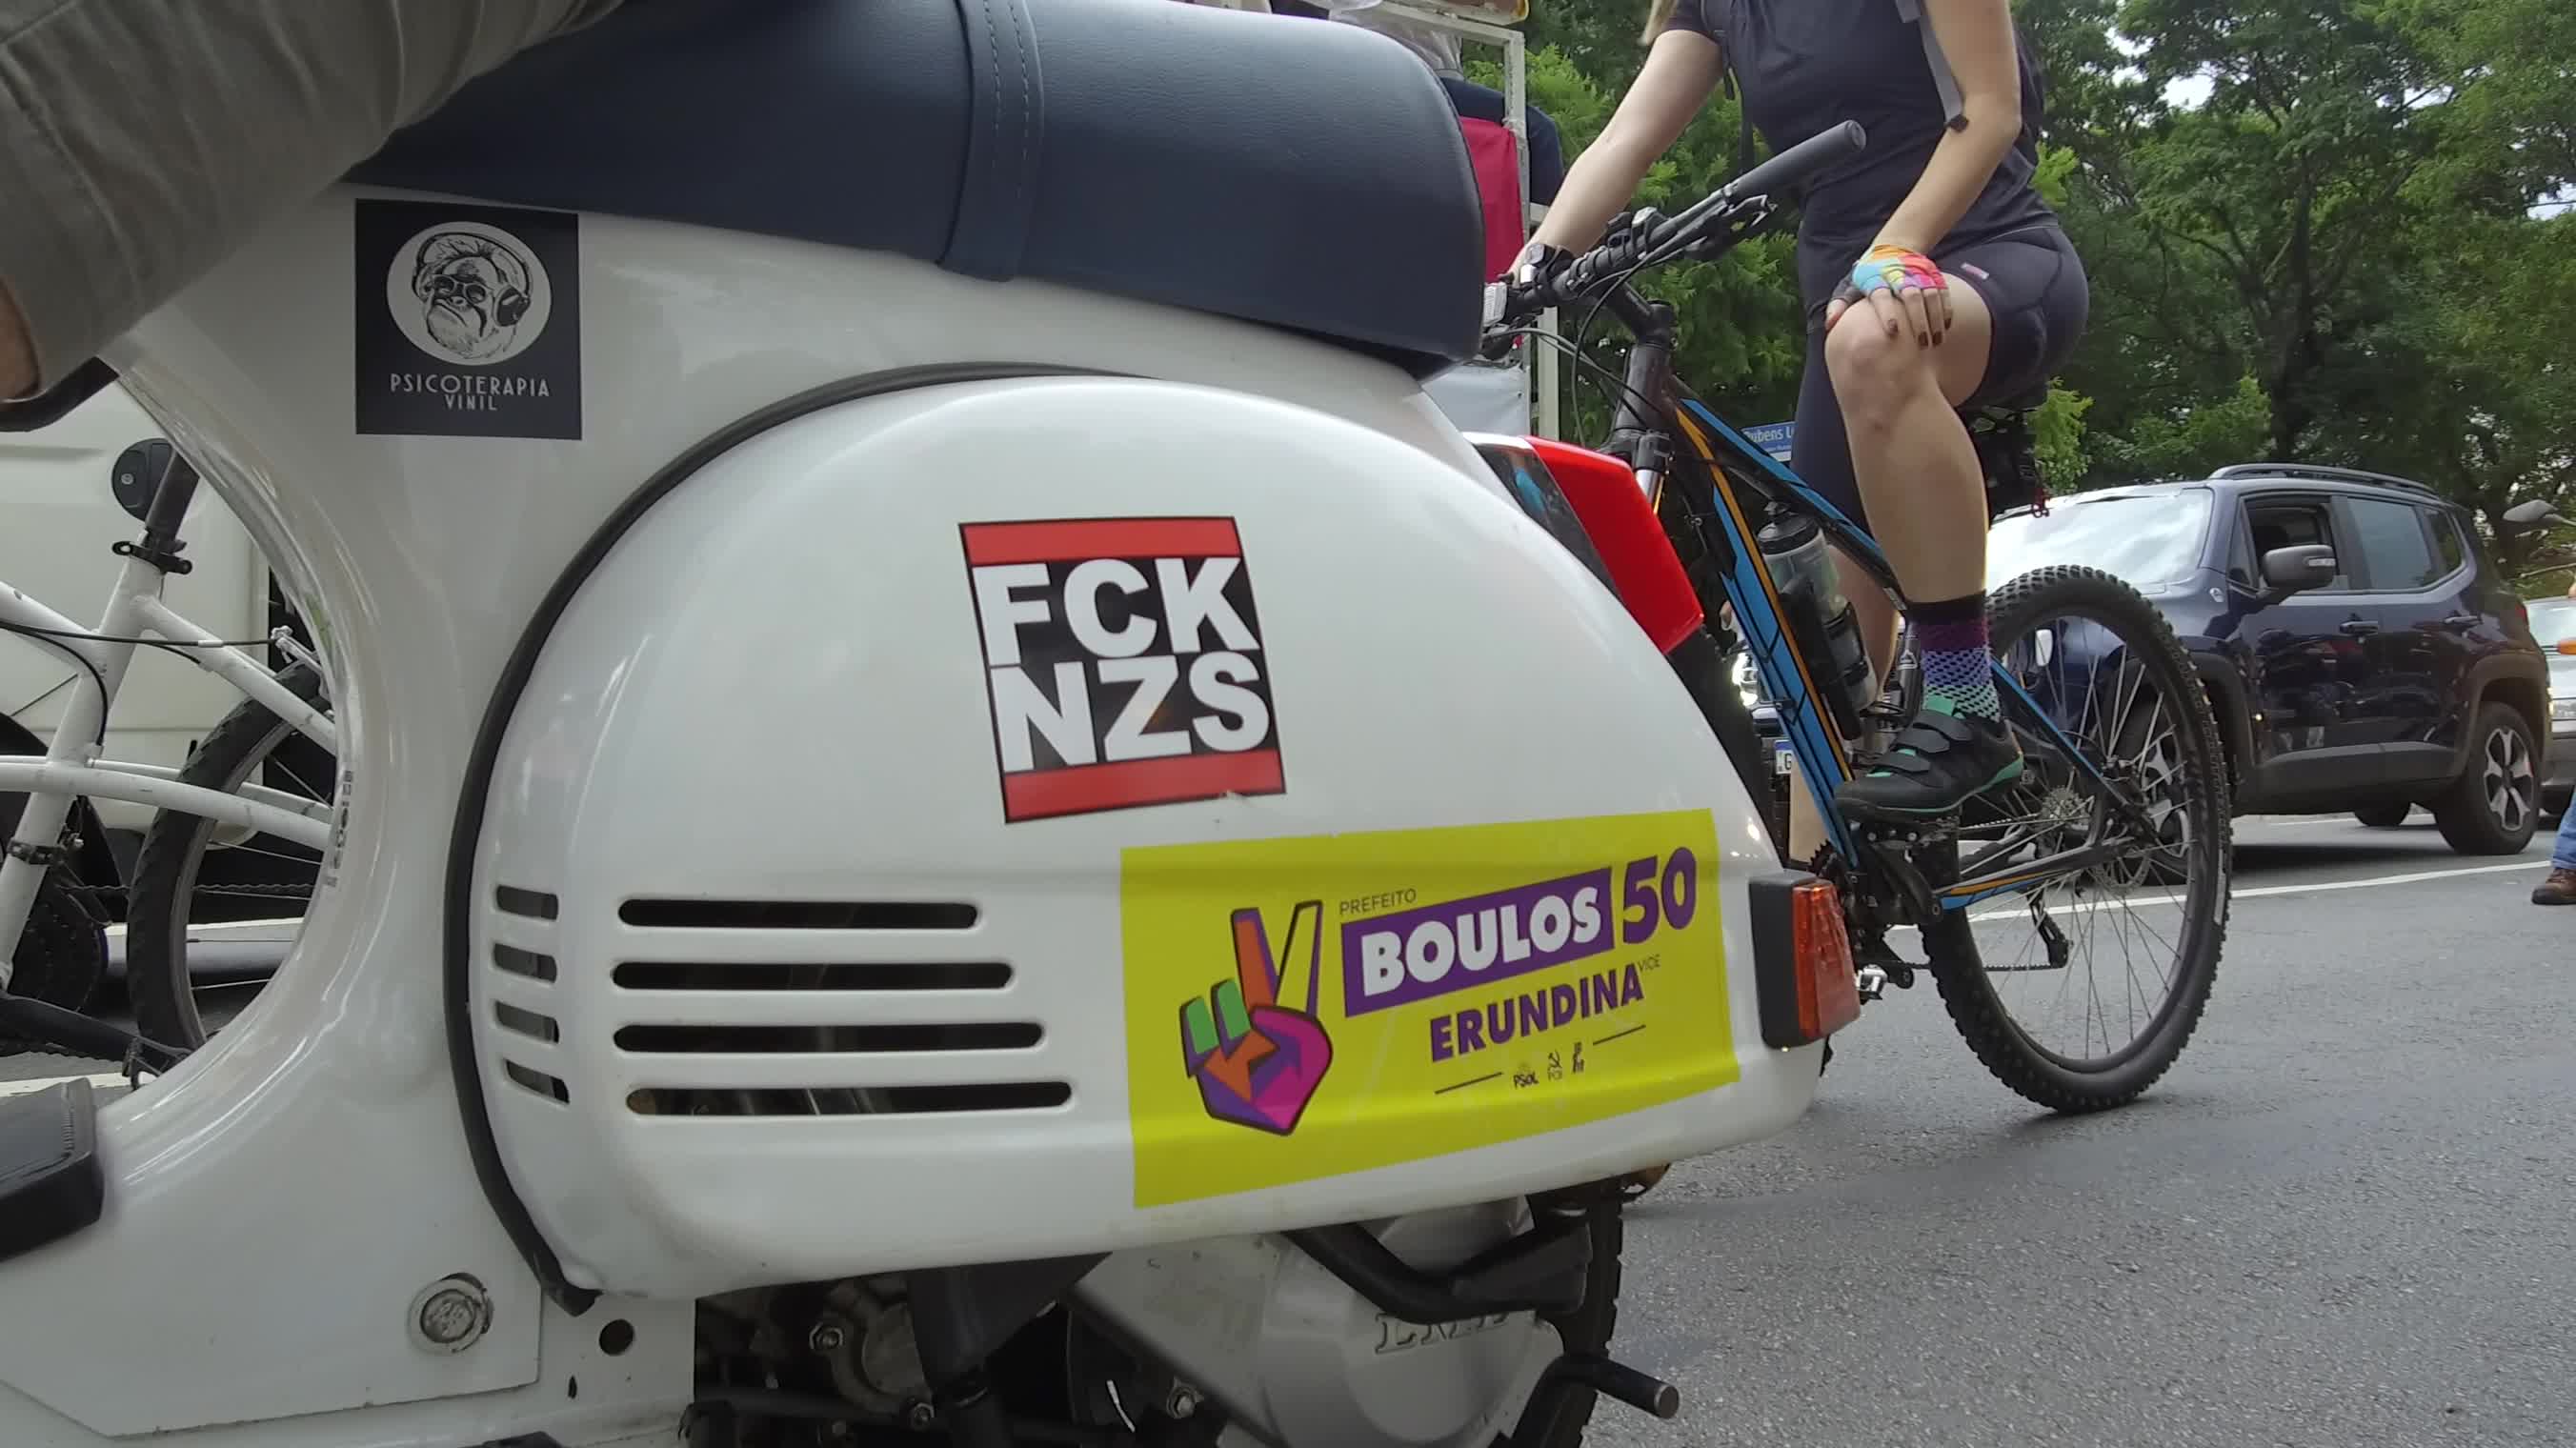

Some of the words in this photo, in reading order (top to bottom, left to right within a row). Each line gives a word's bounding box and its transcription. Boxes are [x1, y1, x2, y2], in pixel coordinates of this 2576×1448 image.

[390, 372, 550, 396] PSICOTERAPIA
[445, 395, 497, 411] VINIL
[972, 557, 1260, 666] FCK
[991, 651, 1269, 773] NZS
[1339, 888, 1417, 915] PREFEITO
[1361, 887, 1601, 996] BOULOS
[1622, 847, 1697, 944] 50
[1430, 963, 1644, 1062] ERUNDINA
